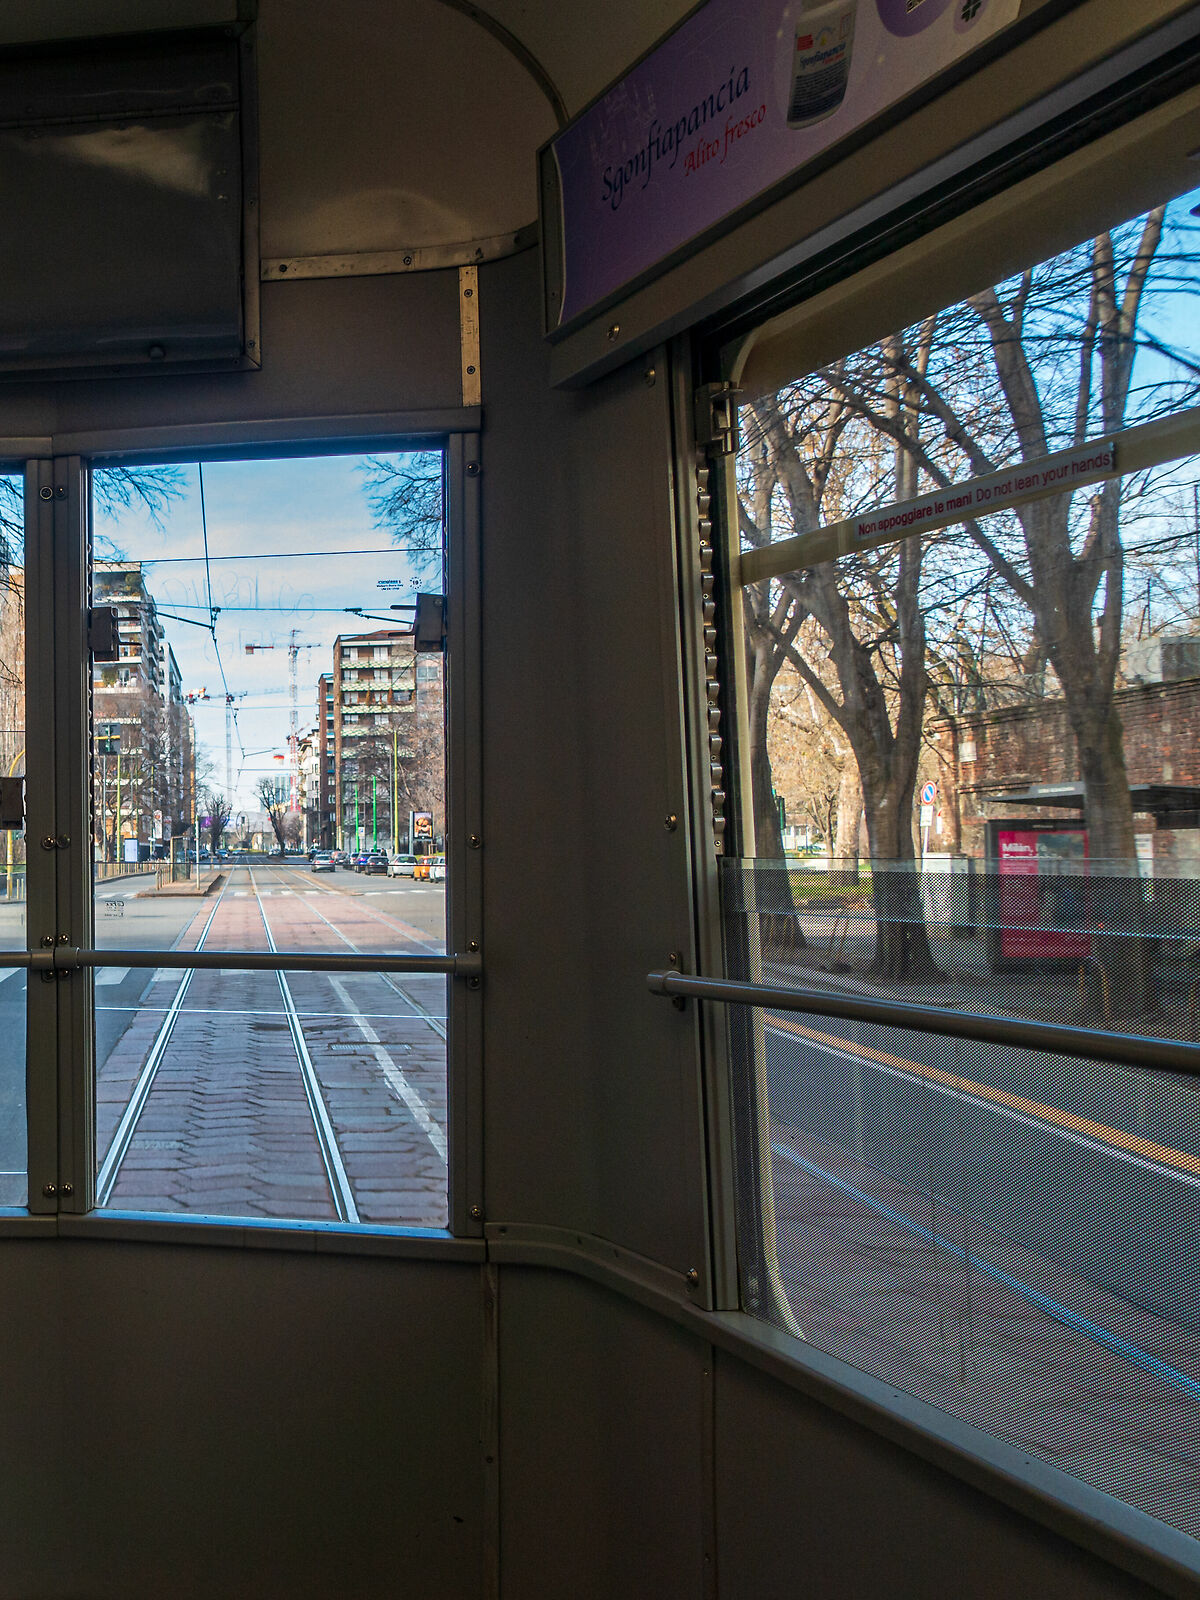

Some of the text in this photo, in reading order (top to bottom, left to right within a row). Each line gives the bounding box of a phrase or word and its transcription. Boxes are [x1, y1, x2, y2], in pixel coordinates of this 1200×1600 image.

[602, 65, 750, 211] Sgonfiapancia
[684, 104, 767, 177] Alito fresco
[858, 452, 1111, 536] Non appoggiare le mani Do not lean your hands
